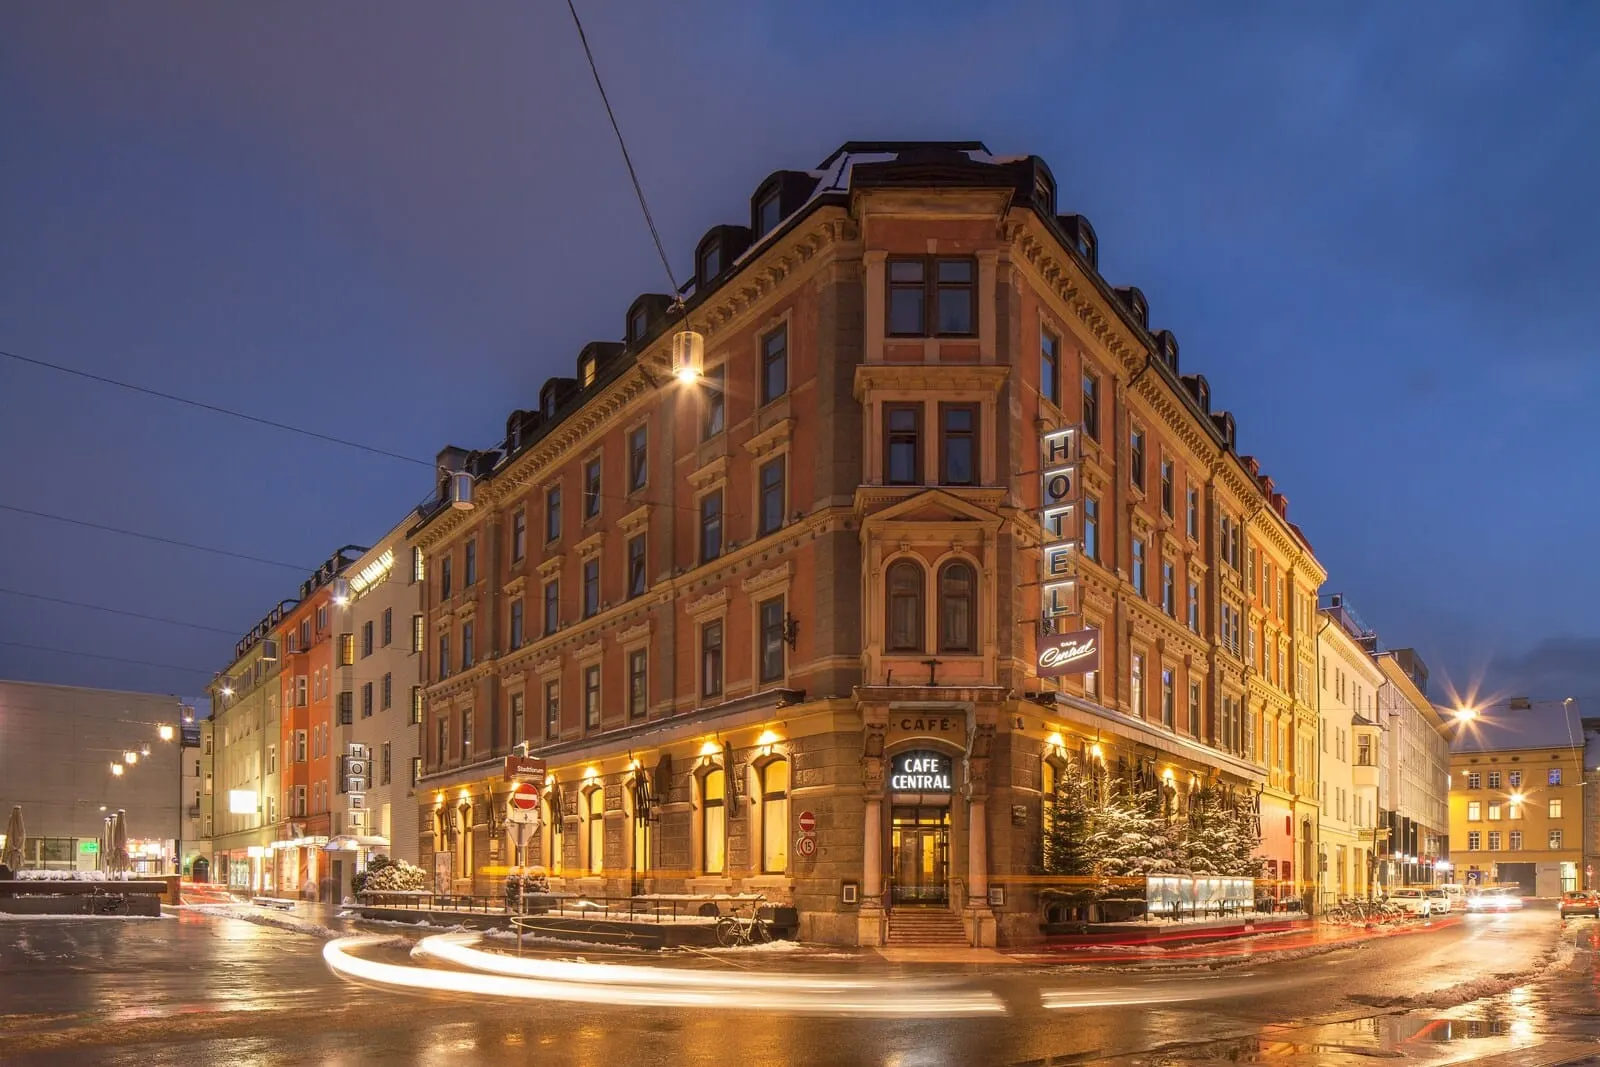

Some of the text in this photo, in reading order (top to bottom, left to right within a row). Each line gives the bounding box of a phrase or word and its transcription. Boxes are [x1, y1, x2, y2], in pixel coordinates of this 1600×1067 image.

[1048, 436, 1070, 613] HOTEL
[1039, 638, 1096, 667] Central
[904, 758, 939, 773] CAFE
[352, 746, 363, 826] HOTEL
[892, 775, 951, 789] CENTRAL
[805, 841, 812, 852] 15
